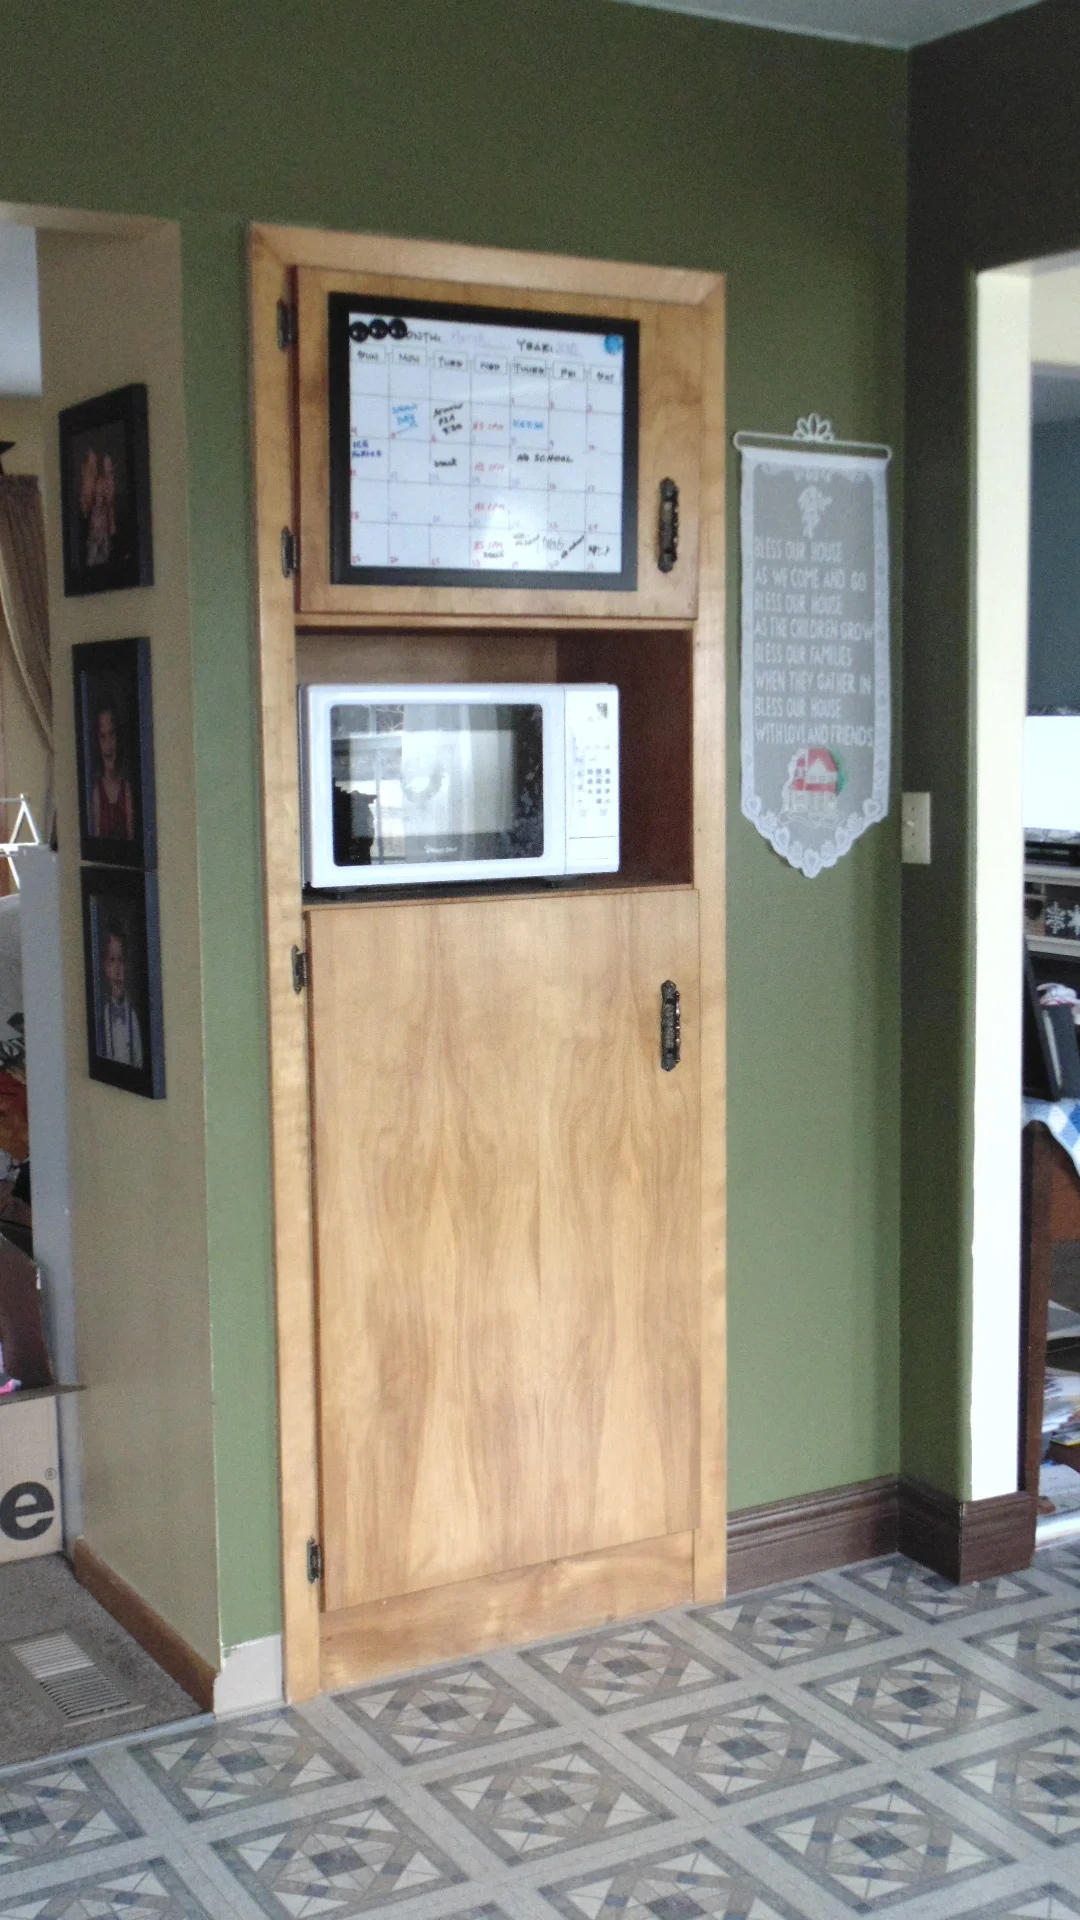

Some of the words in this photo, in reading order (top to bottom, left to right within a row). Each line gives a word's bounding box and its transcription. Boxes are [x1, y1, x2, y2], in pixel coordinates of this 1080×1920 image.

[405, 330, 441, 343] ONTH:
[398, 352, 420, 363] MON
[438, 355, 463, 368] TUES
[560, 367, 576, 379] FRI
[596, 370, 615, 382] SAT
[753, 536, 782, 560] BLESS
[785, 539, 806, 561] OUR
[811, 541, 843, 563] HOUSE
[754, 565, 768, 585] AS
[771, 566, 788, 588] WE
[790, 567, 820, 589] COME
[823, 568, 846, 590] AND
[851, 570, 867, 592] GO
[754, 591, 782, 614] BLESS
[785, 592, 806, 614] OUR
[811, 594, 843, 616] HOUSE
[754, 615, 768, 637] AS
[769, 617, 788, 638] THE
[790, 618, 839, 640] CHILDREN
[840, 621, 874, 642] GROW
[754, 640, 783, 664] BLESS
[785, 643, 806, 665] OUR
[810, 644, 852, 667] FAMILIES
[754, 667, 786, 692] WHEN
[789, 670, 814, 693] THEY
[816, 670, 855, 695] GATHER
[859, 673, 873, 695] IN
[754, 695, 783, 718] BLESS
[786, 697, 806, 719] OUR
[811, 697, 843, 719] HOUSE
[754, 722, 784, 745] WITH
[784, 723, 806, 745] LOVE
[807, 725, 828, 746] AND
[831, 725, 874, 748] FRIENDS
